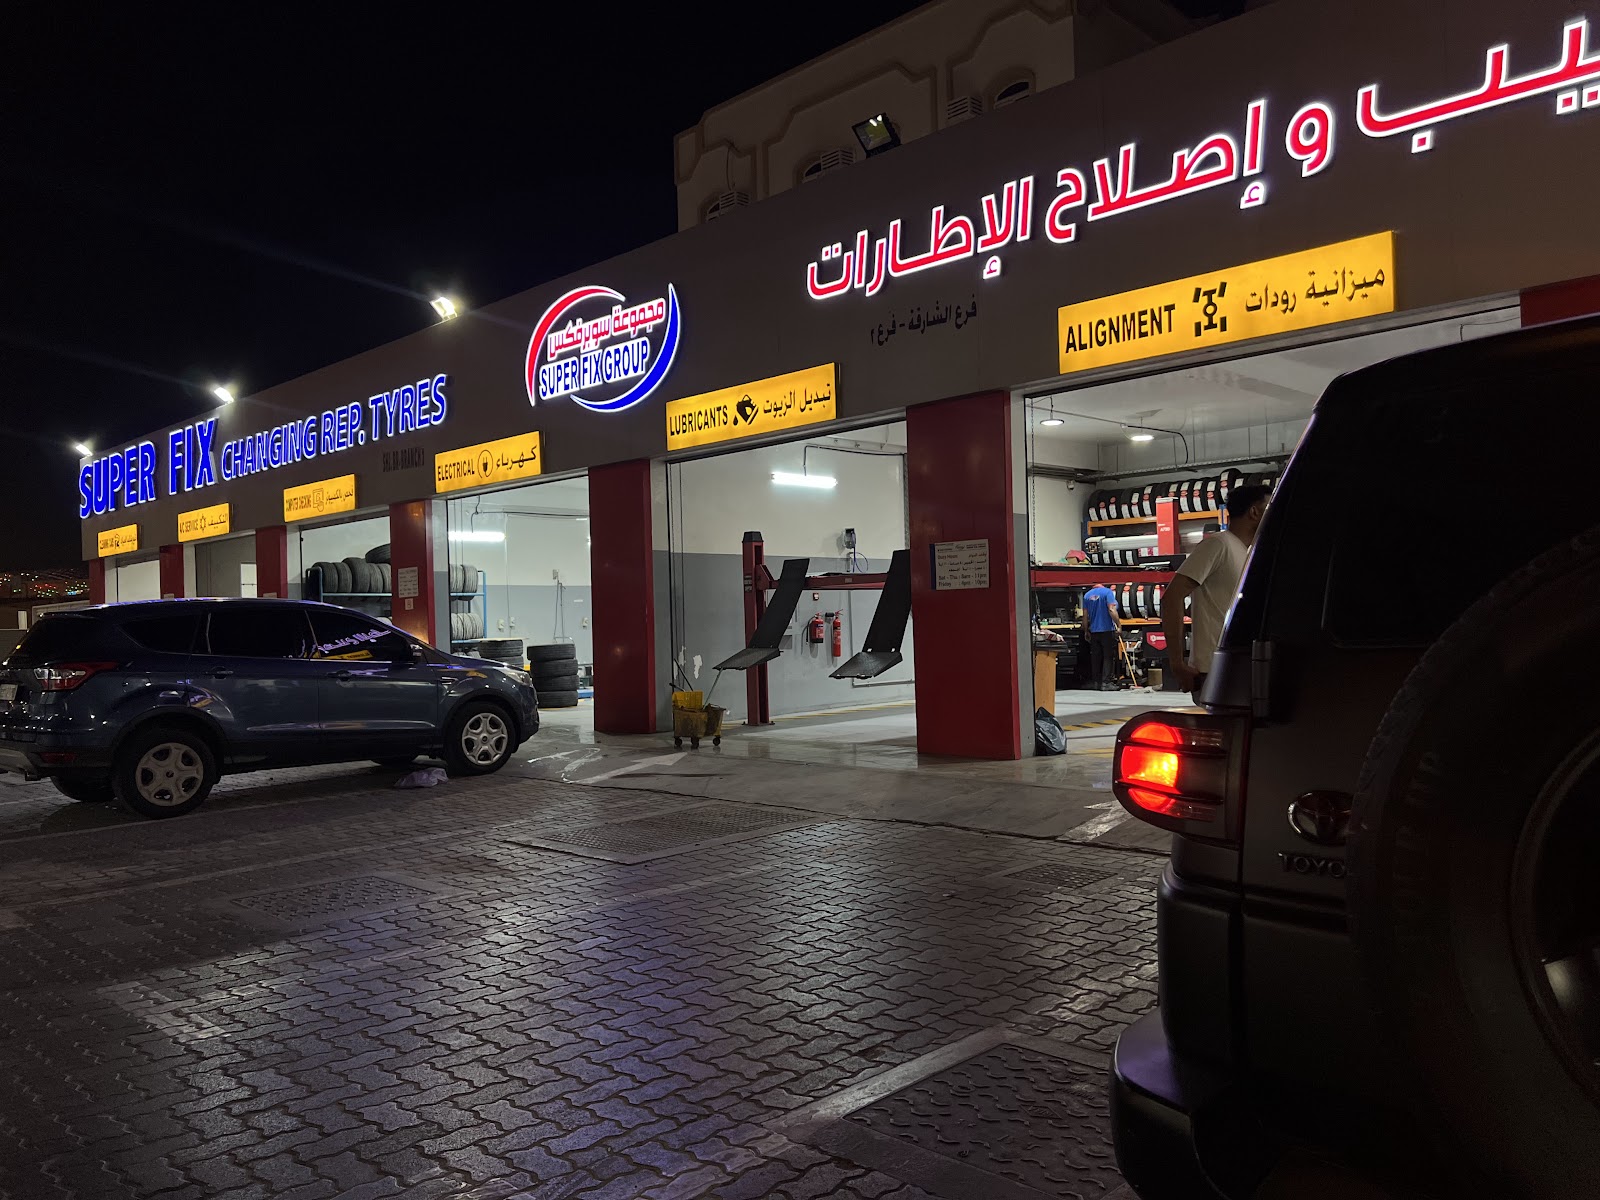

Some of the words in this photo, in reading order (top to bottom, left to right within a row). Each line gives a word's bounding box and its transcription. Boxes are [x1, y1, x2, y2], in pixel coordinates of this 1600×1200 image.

[1356, 18, 1600, 154] يب
[1285, 100, 1333, 178] و
[1045, 98, 1266, 244] إصلاح
[807, 175, 1034, 300] الإطارات
[1245, 284, 1297, 315] رودات
[1305, 266, 1385, 307] ميزانية
[612, 299, 665, 338] مجموعة
[877, 313, 896, 346] فرع
[909, 300, 951, 334] الشارقة
[955, 293, 977, 329] فرع
[1065, 303, 1175, 354] ALIGNMENT
[548, 316, 611, 361] سوبرفكس
[541, 359, 579, 398] SUPER
[582, 352, 602, 387] FIX
[604, 339, 649, 381] GROUP
[763, 389, 796, 418] الزيوت
[799, 383, 831, 413] تبديل
[669, 404, 728, 437] LUBRICANTS
[79, 441, 156, 519] SUPER
[169, 417, 217, 496] FIX
[221, 416, 317, 482] CHANGING
[321, 401, 366, 456] REP.
[368, 373, 448, 442] TYRES
[496, 444, 538, 471] كهرباء
[438, 458, 475, 482] ELECTRICAL
